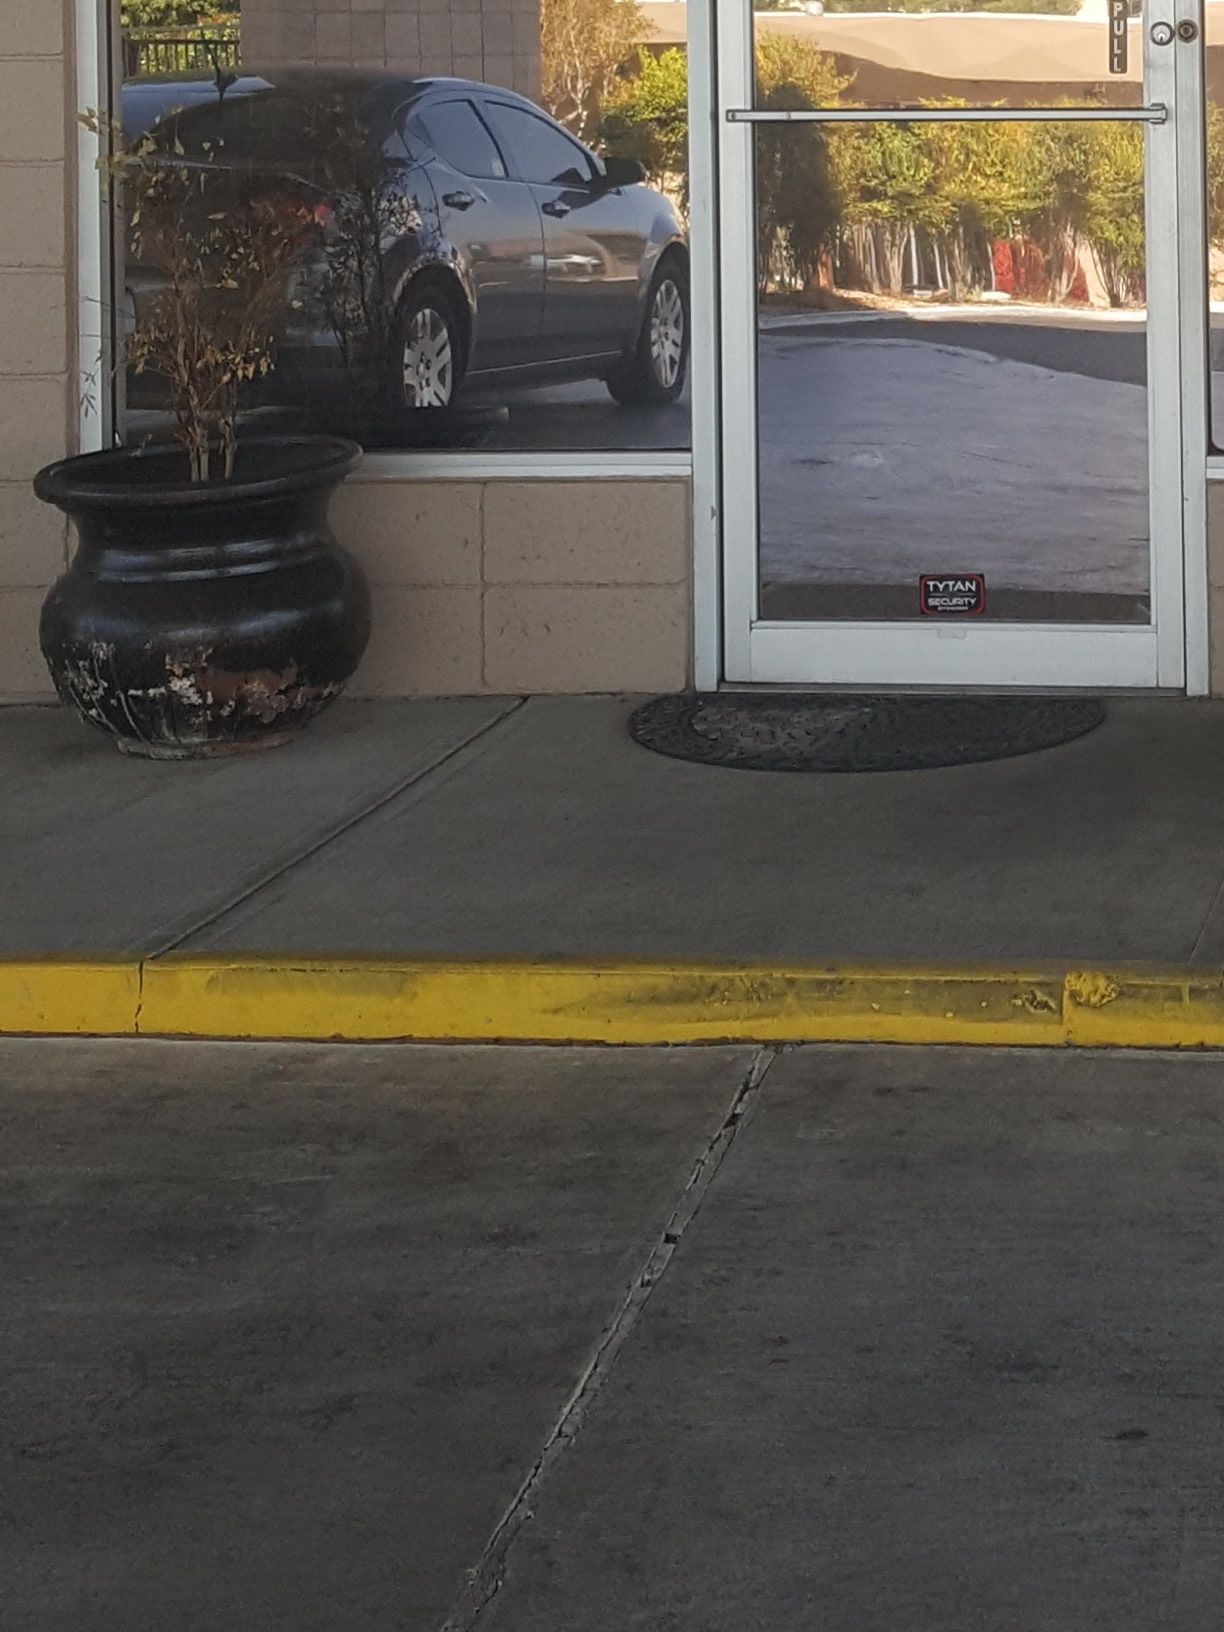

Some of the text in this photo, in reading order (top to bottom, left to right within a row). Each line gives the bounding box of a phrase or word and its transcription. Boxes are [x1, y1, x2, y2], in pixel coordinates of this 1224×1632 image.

[1113, 2, 1125, 73] PULL
[926, 580, 977, 593] TYTAN
[927, 597, 977, 607] SECURITY
